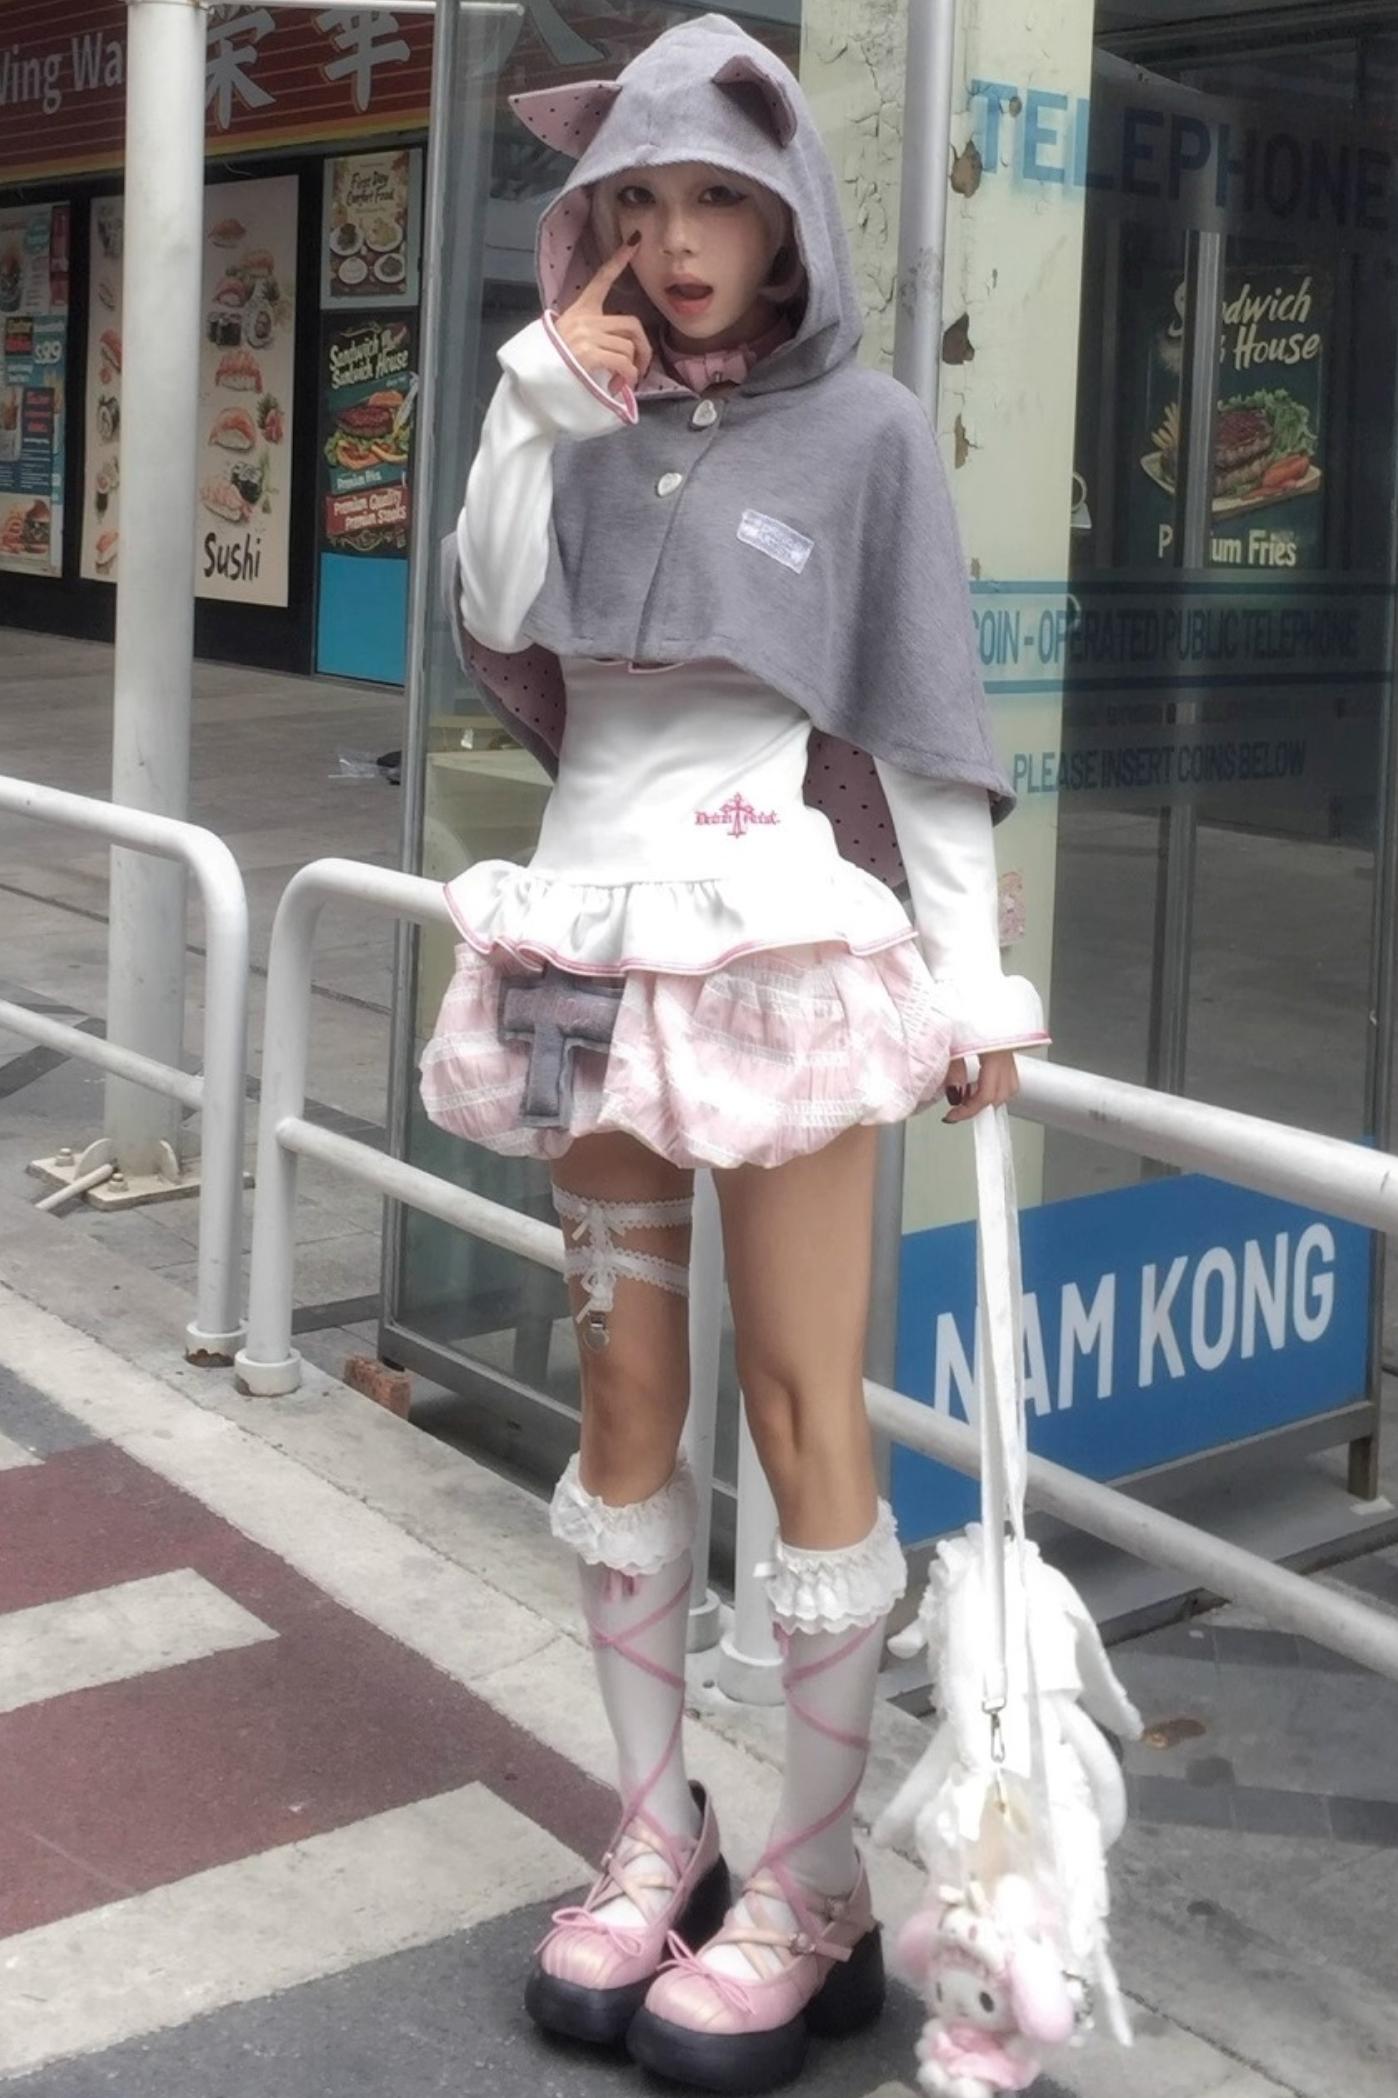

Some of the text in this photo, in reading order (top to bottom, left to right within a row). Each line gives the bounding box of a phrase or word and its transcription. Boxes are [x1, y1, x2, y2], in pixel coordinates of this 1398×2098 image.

[971, 78, 1390, 231] TELEPHONE
[1233, 324, 1320, 371] House
[203, 532, 261, 581] Sushi
[1248, 529, 1297, 567] Fries
[1013, 748, 1098, 793] PLEASE
[1101, 745, 1175, 789] INSERT
[1138, 1222, 1336, 1388] KONG
